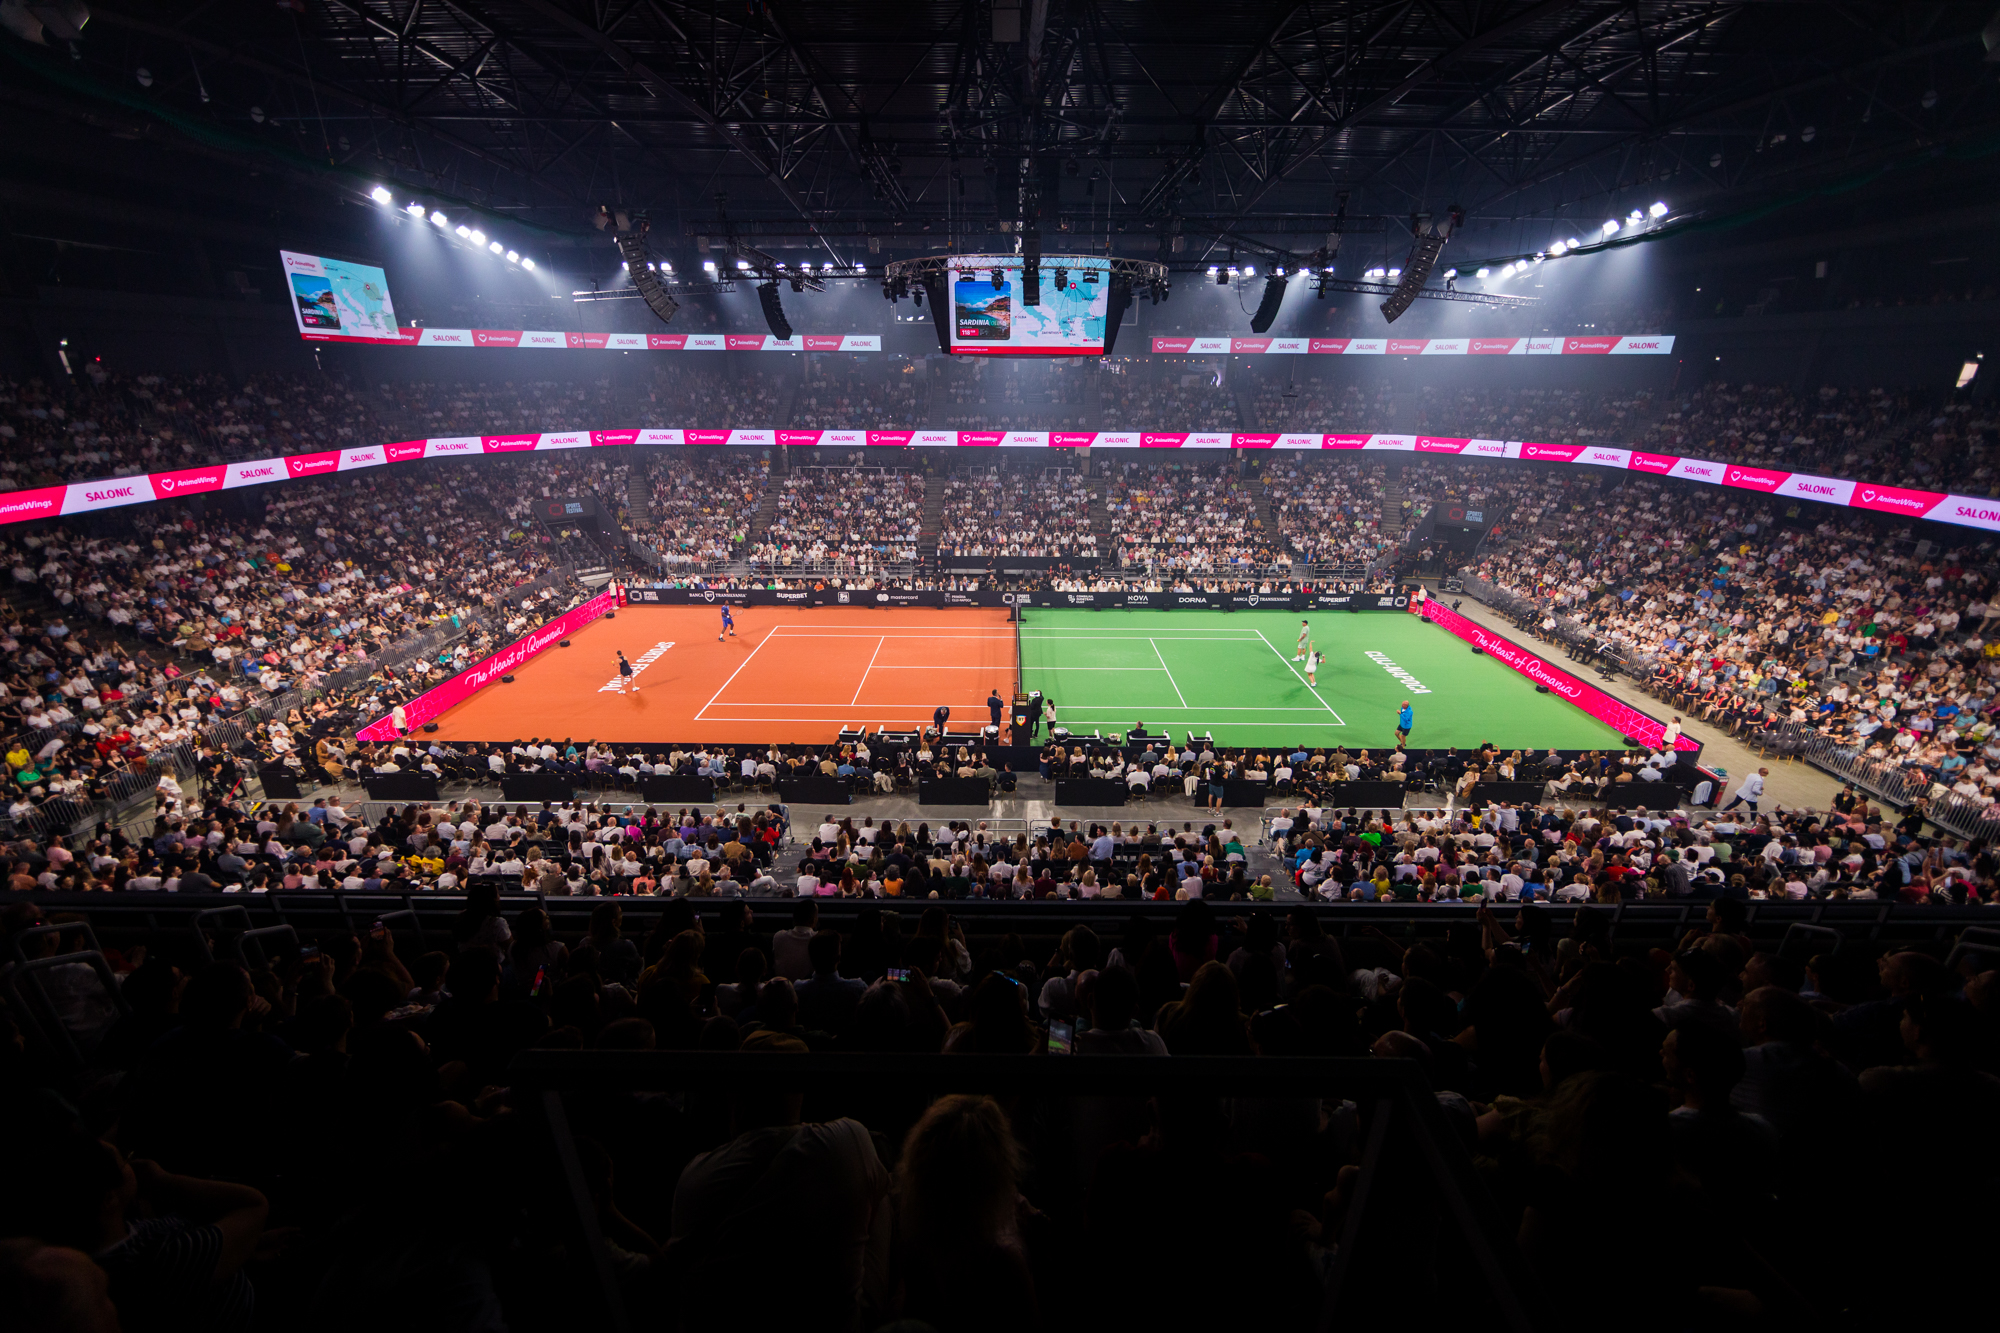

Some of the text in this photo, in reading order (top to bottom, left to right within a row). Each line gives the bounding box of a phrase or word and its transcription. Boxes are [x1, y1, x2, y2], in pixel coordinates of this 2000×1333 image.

[0, 500, 52, 514] nimaWings
[84, 486, 136, 503] SALONIC
[177, 476, 218, 487] AnimaWings
[239, 466, 276, 481] SALONIC
[304, 460, 334, 469] AnimaWings
[349, 452, 376, 463] SALONIC
[1429, 442, 1461, 450] AnimaWings
[1537, 450, 1574, 458] AnimaWings
[1593, 452, 1621, 463] SALONIC
[1641, 460, 1669, 470] AnimaWings
[1683, 466, 1713, 477] SALONIC
[1740, 474, 1777, 486] AnimaWings
[1795, 482, 1837, 497] SALONIC
[1876, 494, 1924, 509] AnimaWings
[464, 622, 566, 687] The Heart of Romania
[636, 642, 676, 662] SPORTS
[1364, 651, 1432, 694] CLUJ-NAPOCA
[1472, 630, 1582, 697] The Heart of Romania
